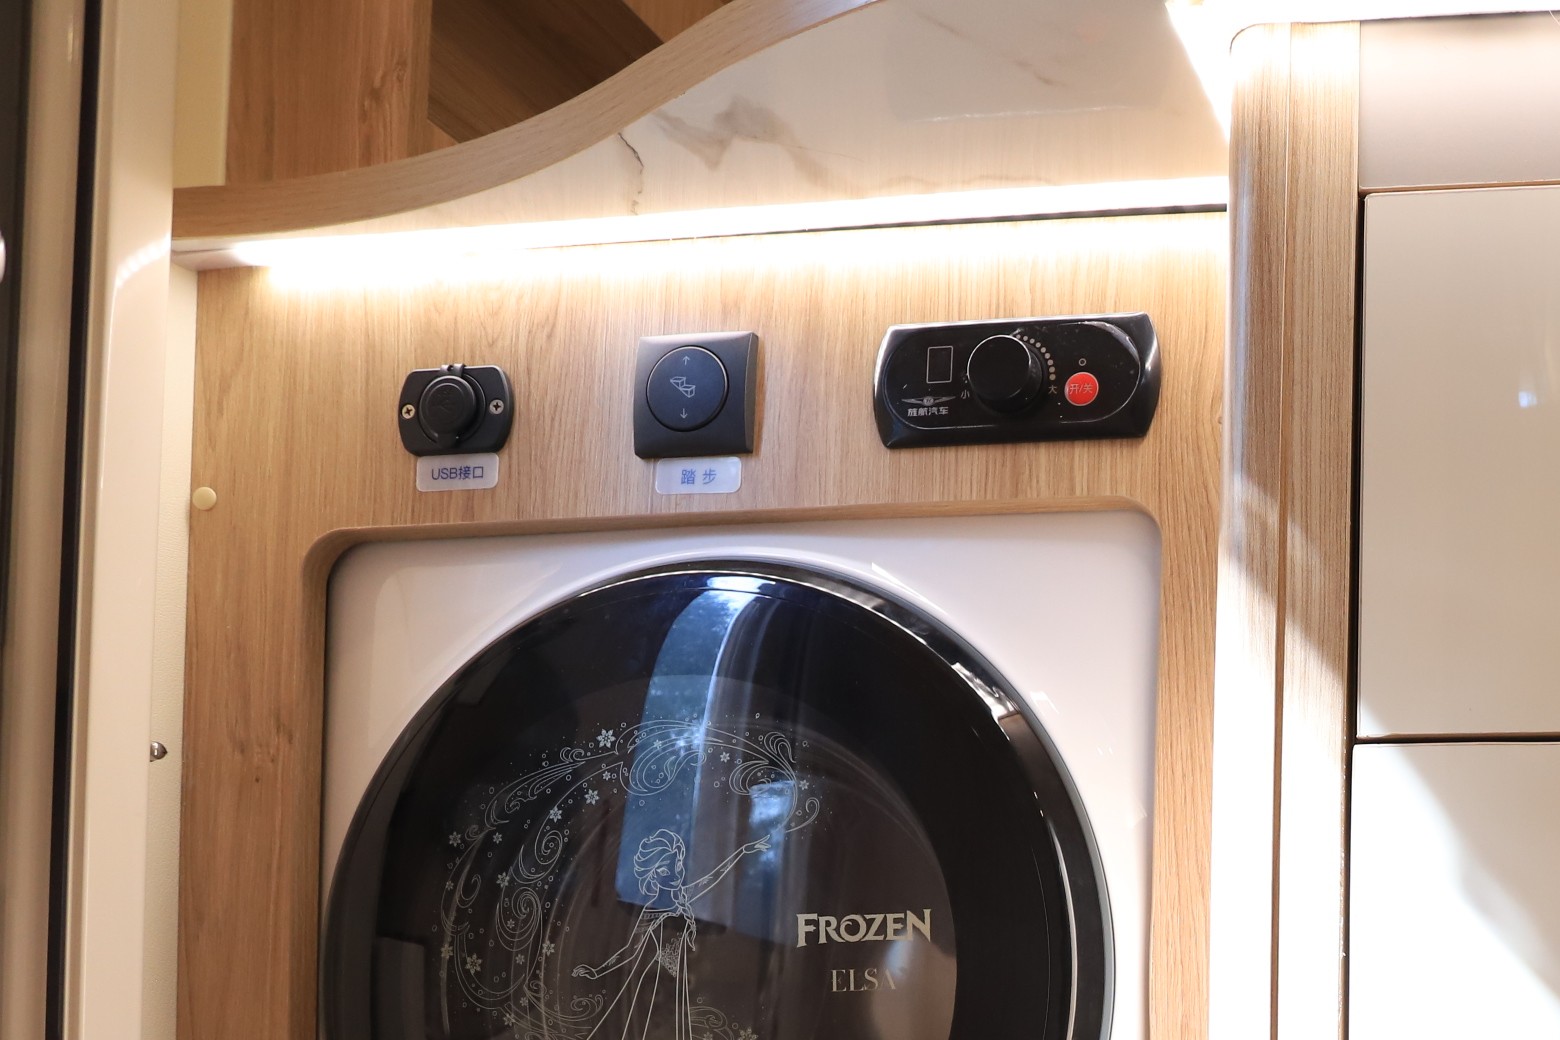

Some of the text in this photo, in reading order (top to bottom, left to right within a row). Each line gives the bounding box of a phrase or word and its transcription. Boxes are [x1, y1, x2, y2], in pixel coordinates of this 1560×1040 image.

[960, 390, 970, 400] 小
[1048, 385, 1058, 395] 大
[1069, 382, 1093, 395] 开/关
[431, 465, 484, 481] USB接口
[796, 908, 932, 948] FROZEN
[831, 967, 896, 992] ELSA
